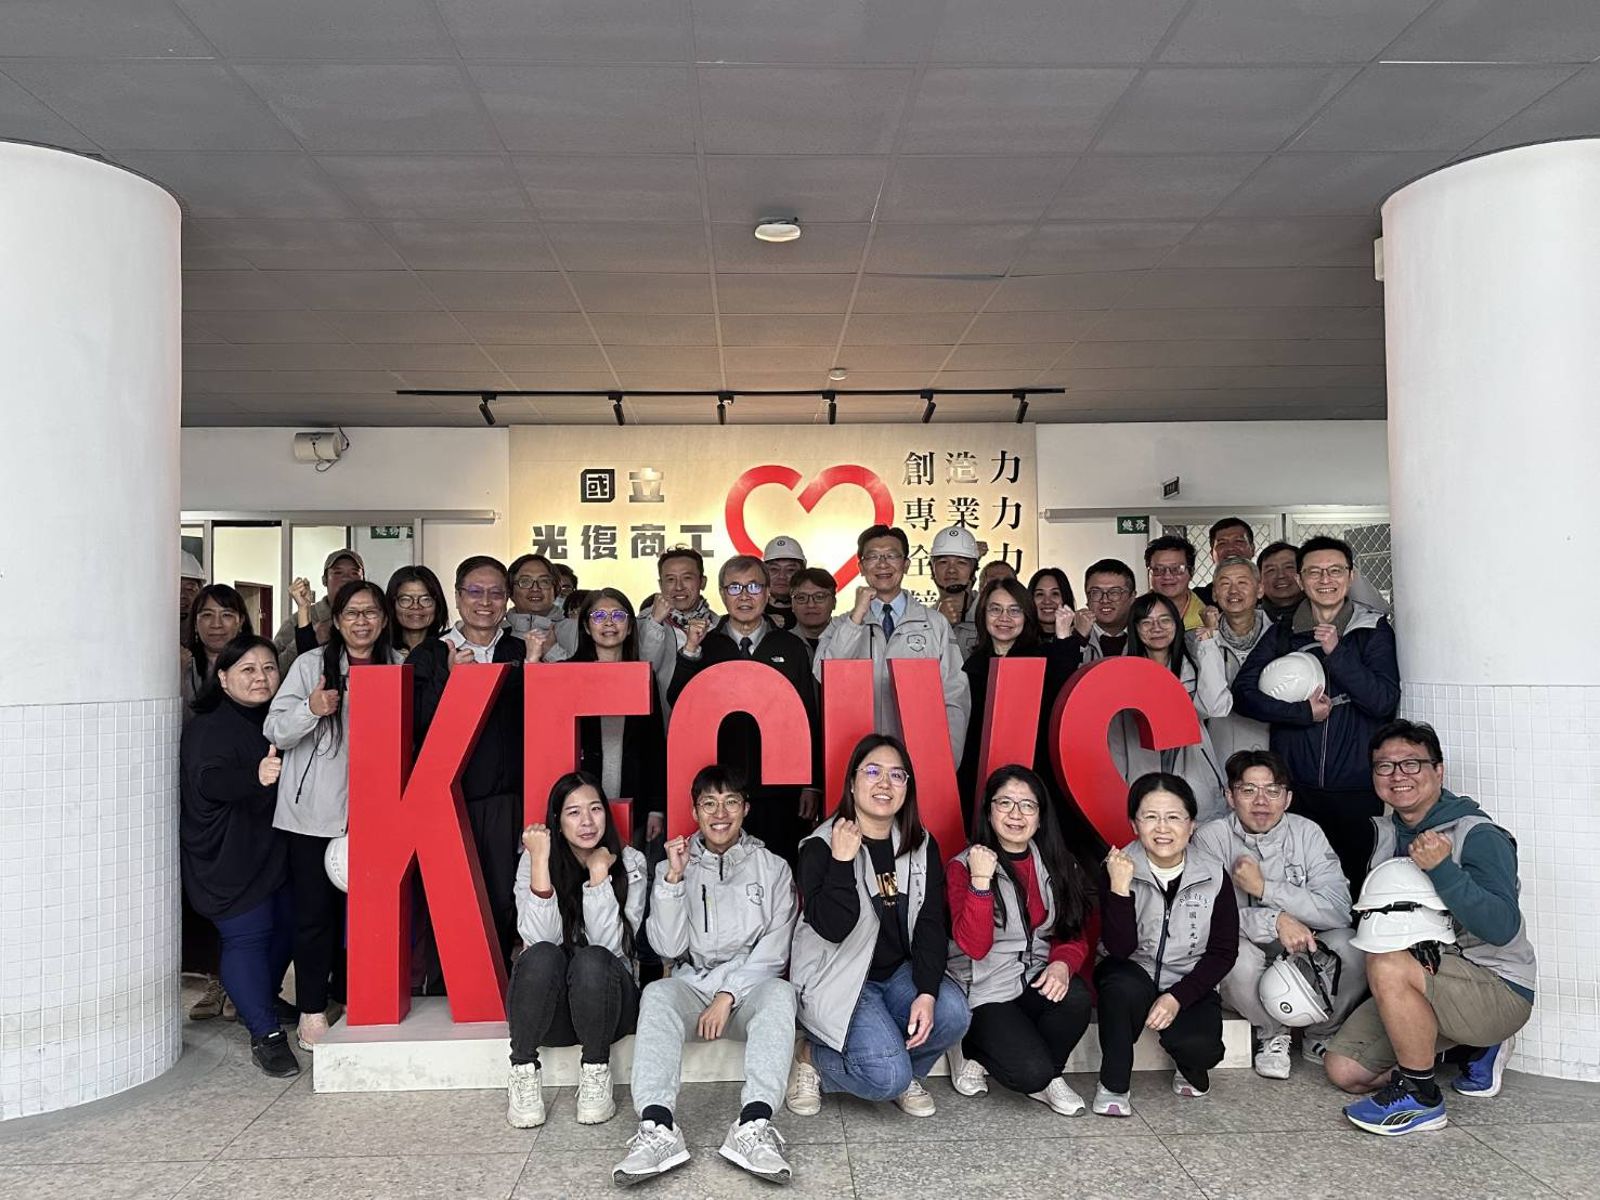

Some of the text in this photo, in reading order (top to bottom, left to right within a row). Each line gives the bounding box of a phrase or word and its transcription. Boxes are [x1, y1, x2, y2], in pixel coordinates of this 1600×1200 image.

[580, 467, 665, 503] 國立
[902, 450, 1021, 486] 創造力
[903, 496, 1022, 531] 專業力
[532, 523, 715, 560] 光復商工
[904, 543, 1024, 577] 全力
